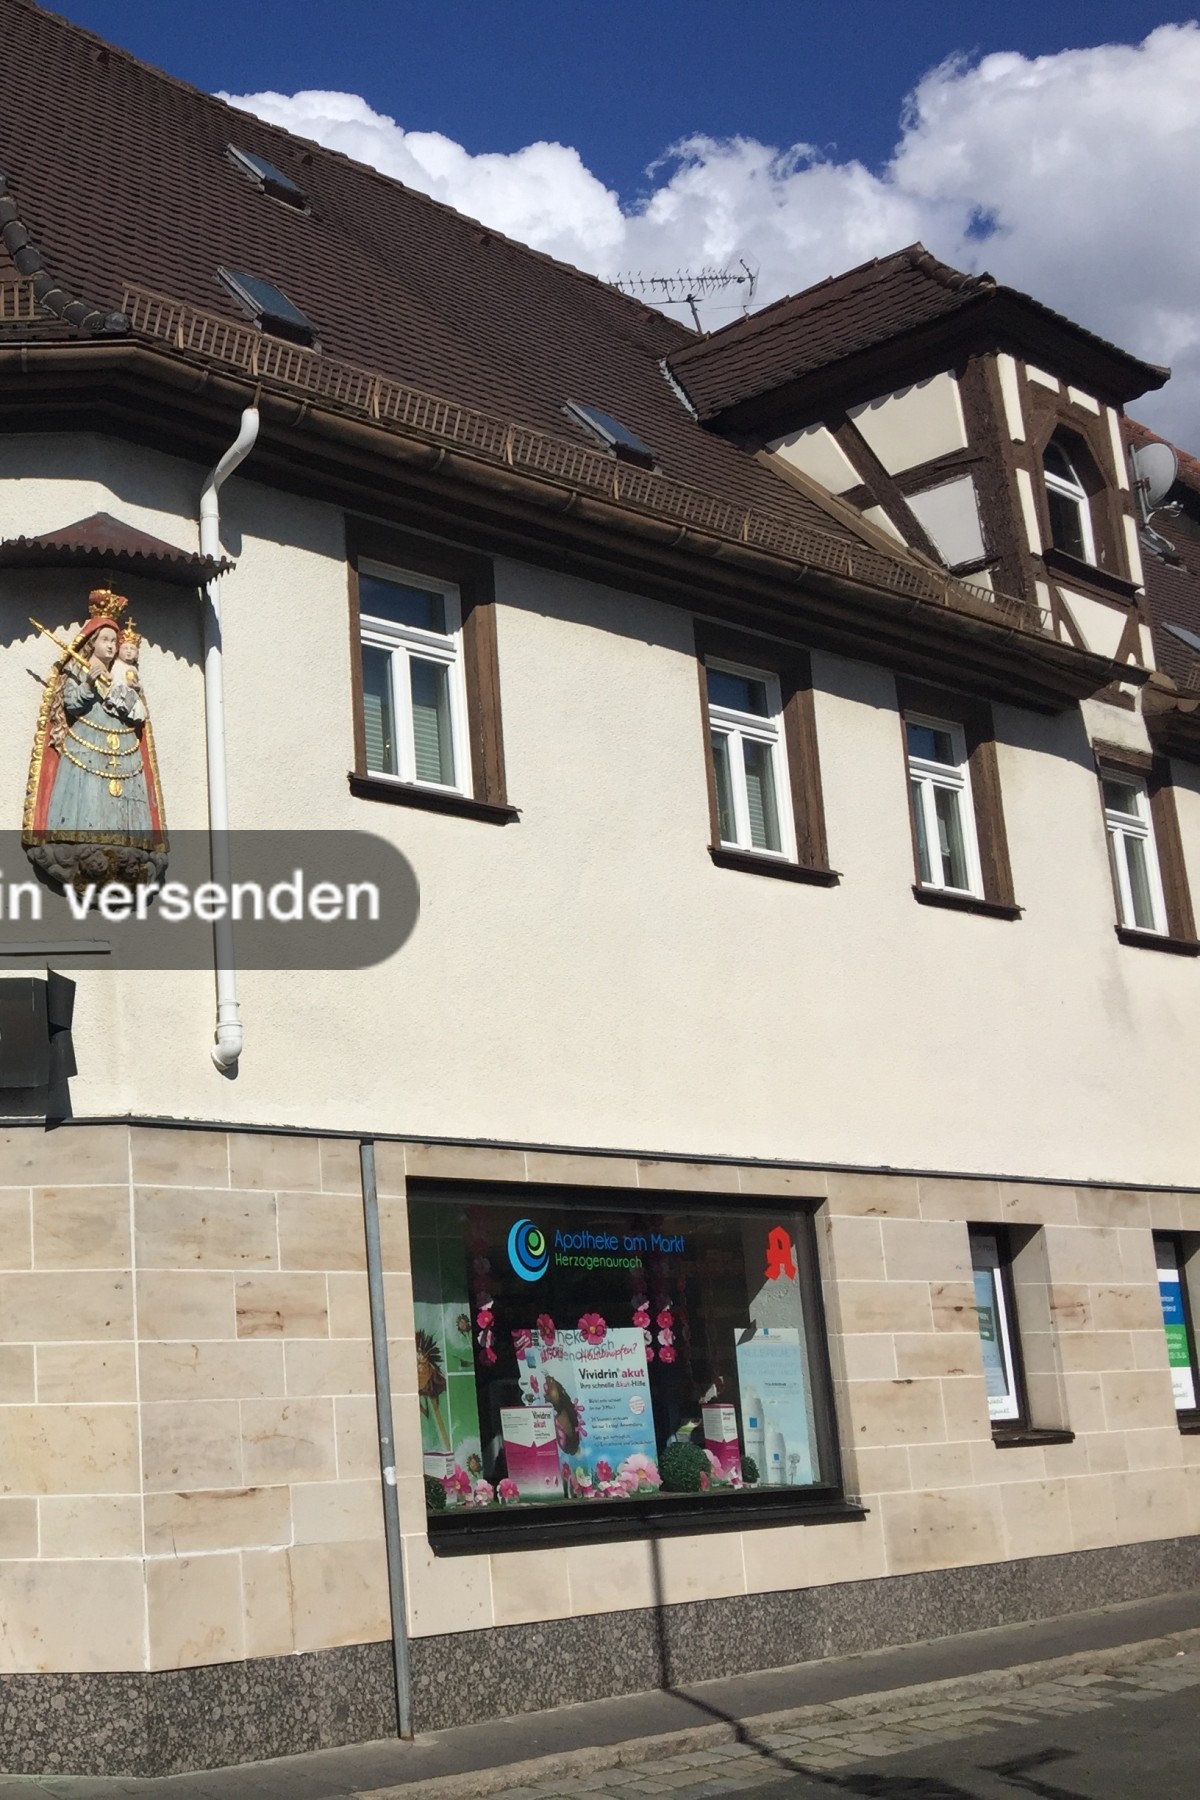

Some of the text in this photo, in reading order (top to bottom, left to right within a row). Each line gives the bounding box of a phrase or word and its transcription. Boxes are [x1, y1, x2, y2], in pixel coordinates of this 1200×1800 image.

[554, 1229, 685, 1253] Apotheke am Markt
[554, 1253, 643, 1270] Herzogenaurach
[621, 1368, 645, 1378] akut
